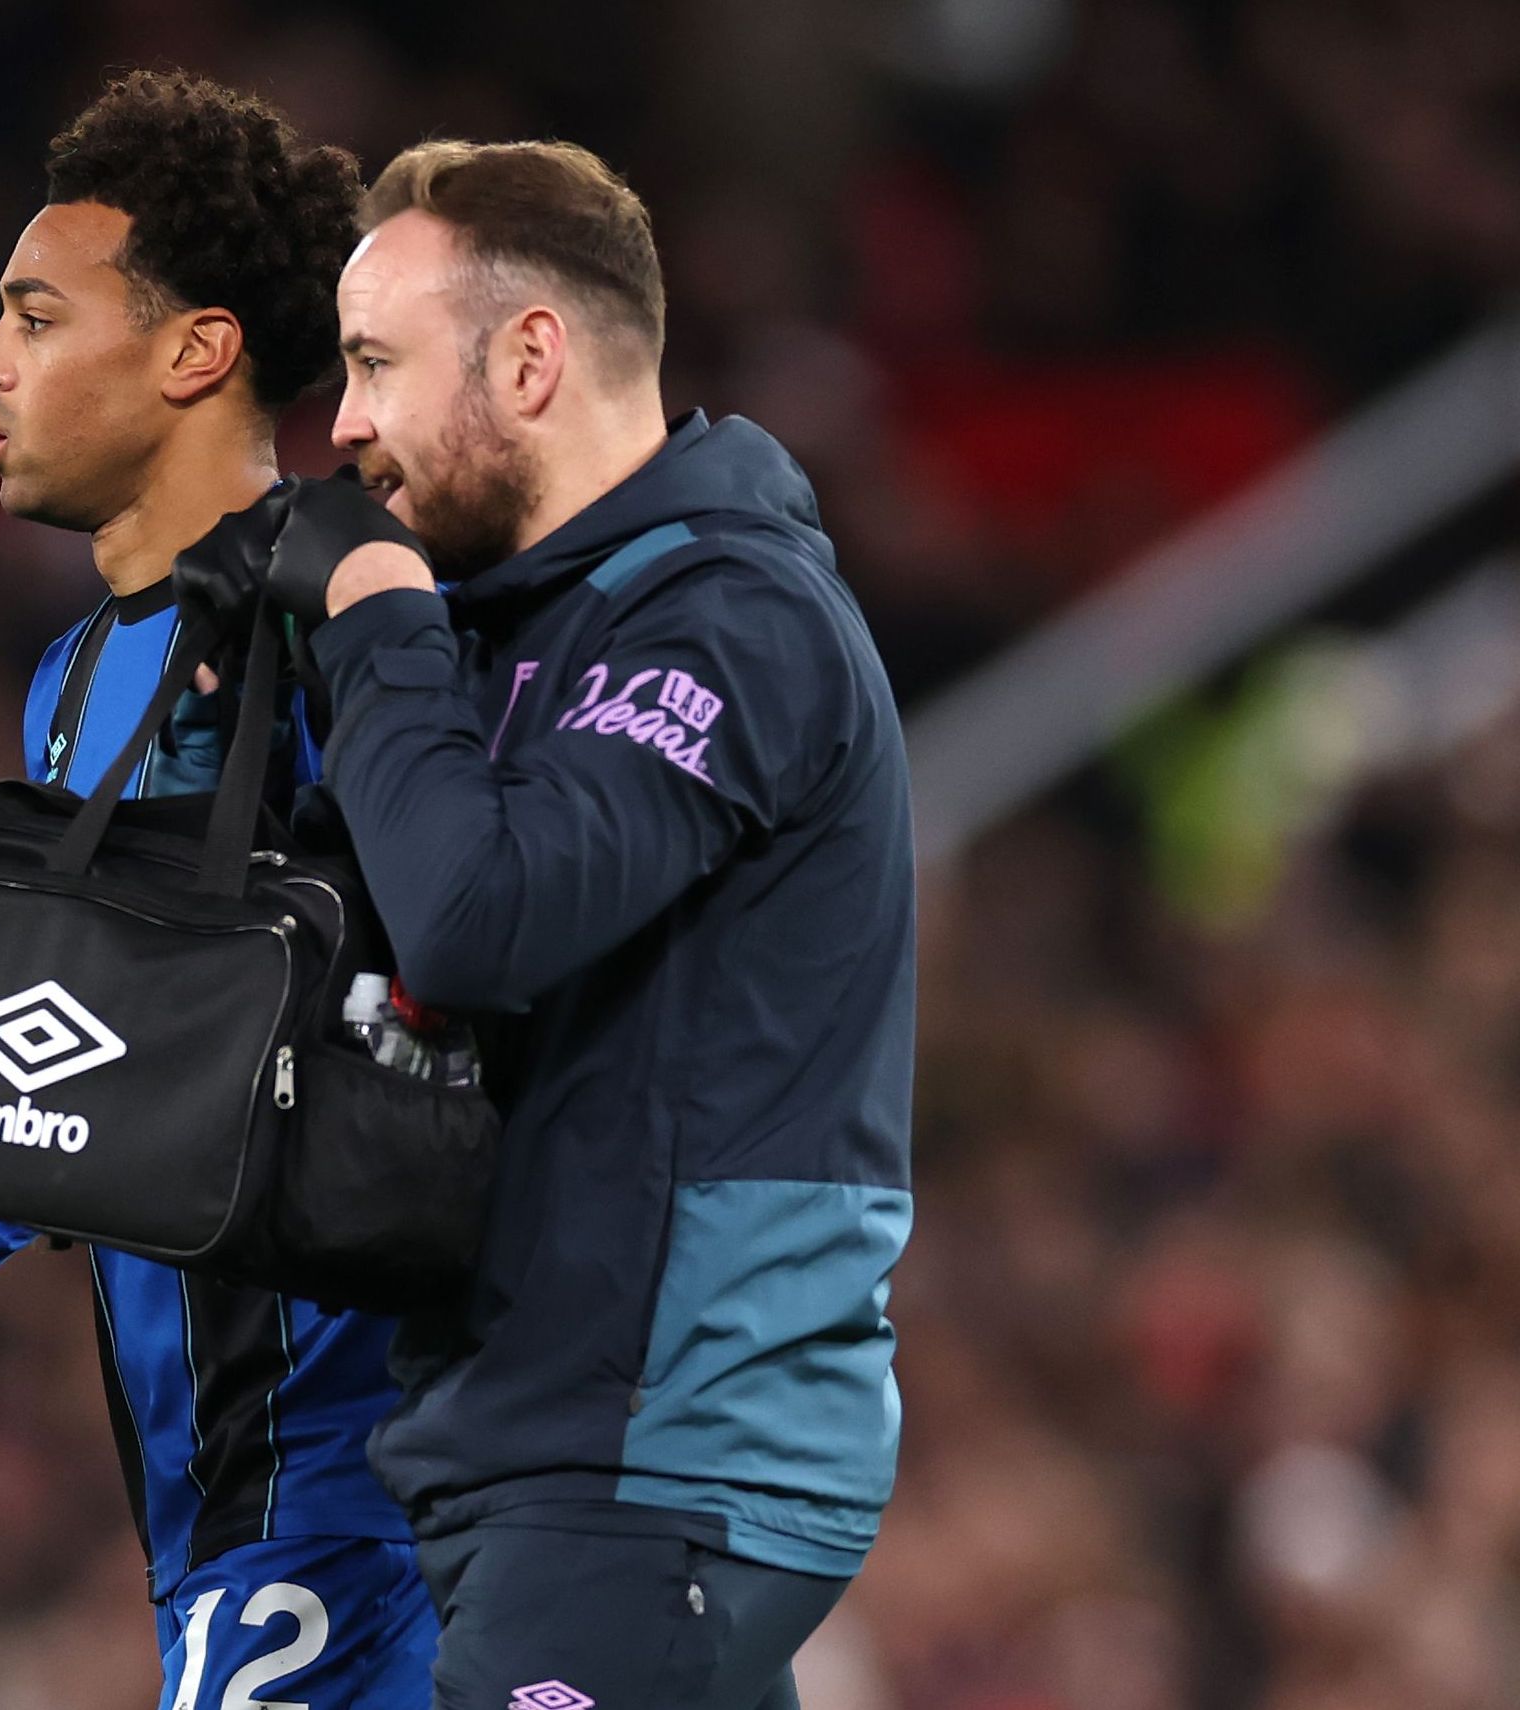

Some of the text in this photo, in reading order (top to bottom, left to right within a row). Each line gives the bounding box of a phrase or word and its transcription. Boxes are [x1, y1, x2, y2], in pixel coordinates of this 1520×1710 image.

[556, 663, 715, 787] Vegas
[663, 673, 719, 727] LAS
[173, 1582, 329, 1710] 12
